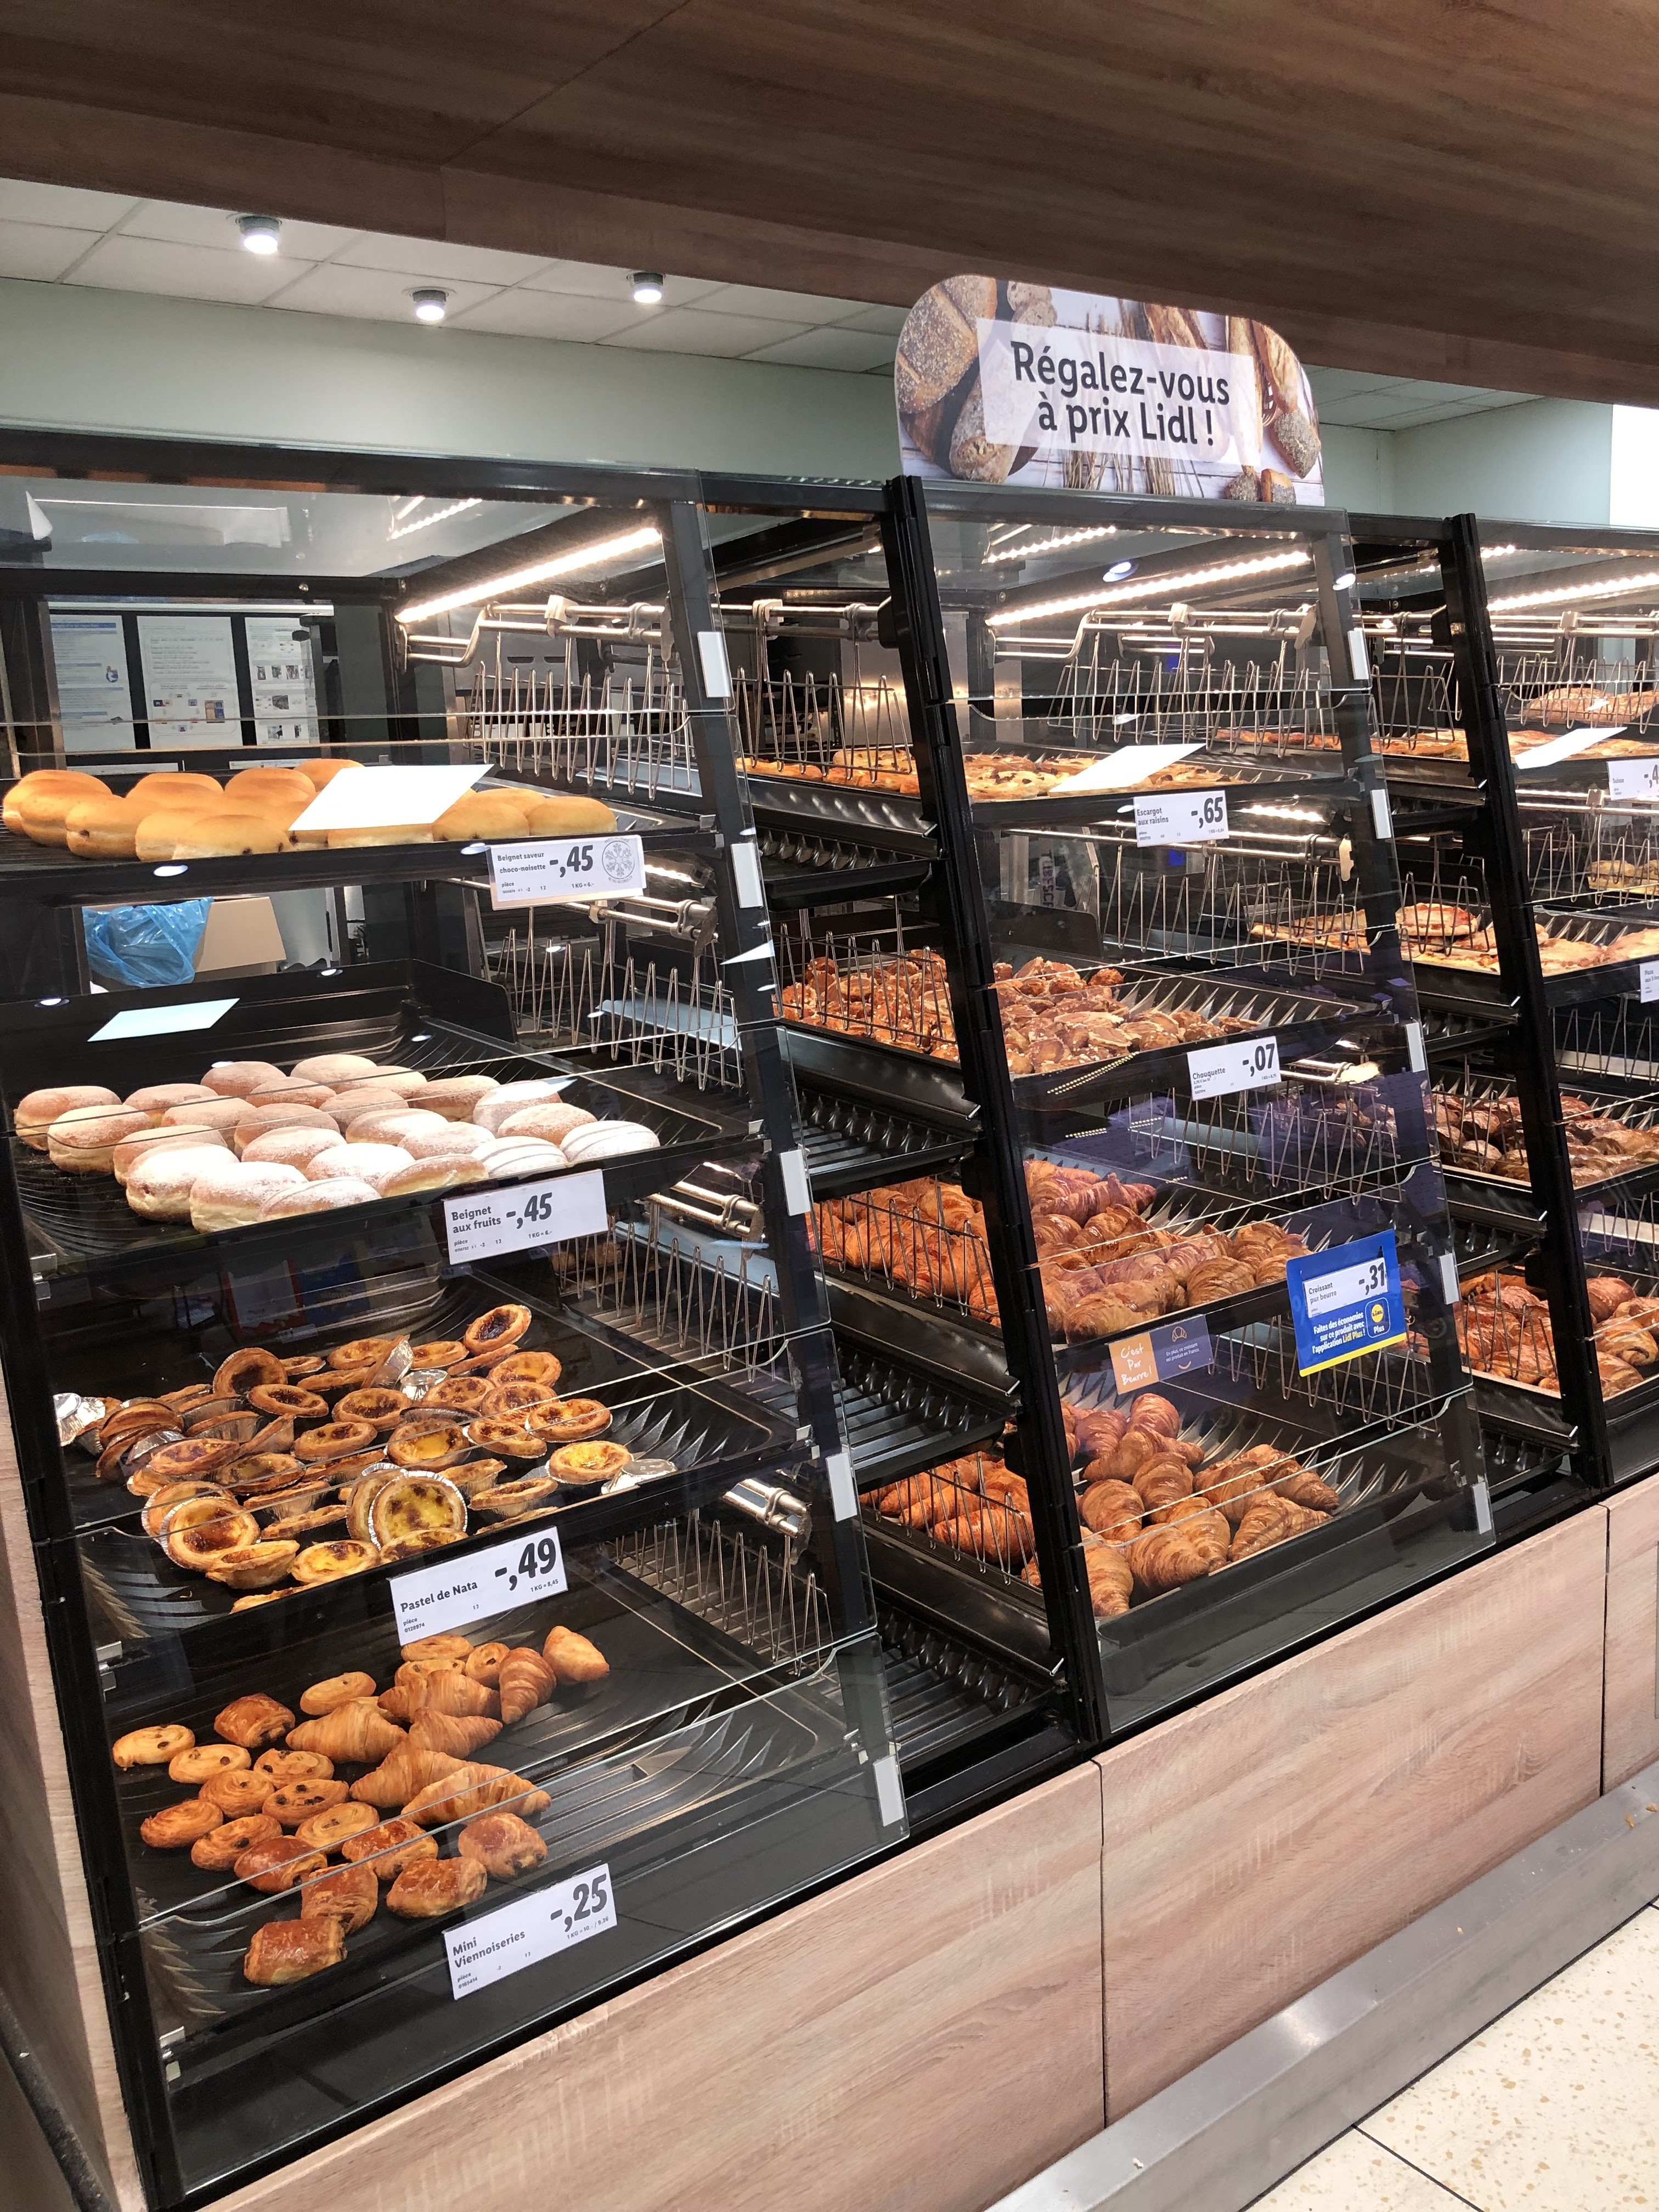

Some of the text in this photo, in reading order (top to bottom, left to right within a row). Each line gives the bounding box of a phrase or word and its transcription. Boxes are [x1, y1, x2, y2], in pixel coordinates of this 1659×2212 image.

[1011, 341, 1229, 405] Régalez-vous
[1039, 392, 1213, 446] à prix Lidl !
[1137, 808, 1163, 816] Escargot
[1191, 797, 1223, 828] -,65
[1150, 816, 1169, 825] raisins
[498, 854, 522, 862] Beignet
[550, 845, 594, 878] -,45
[500, 864, 546, 873] choco-noisette
[1242, 1043, 1275, 1077] -,07
[1193, 1068, 1226, 1080] Chouquette
[451, 1206, 492, 1221] Beignet
[506, 1192, 552, 1229] -,45
[453, 1217, 501, 1233] aux fruits
[1358, 1262, 1385, 1295] -,31
[1308, 1282, 1333, 1294] Croissant
[1319, 1291, 1337, 1301] beurre
[1313, 1312, 1364, 1334] Faites des économies
[1335, 1324, 1353, 1338] produit
[1353, 1321, 1365, 1330] avec
[1373, 1325, 1385, 1334] Plus
[1312, 1338, 1342, 1354] l'application
[1342, 1332, 1352, 1343] Lidl
[1352, 1330, 1363, 1340] Plus
[1120, 1343, 1144, 1358] C'est
[1127, 1359, 1141, 1370] Pur
[495, 1538, 556, 1591] -,49
[548, 1579, 558, 1588] 8,45
[400, 1582, 478, 1612] Pastel de Nata
[403, 1617, 417, 1627] pièce
[404, 1622, 425, 1633] 0128974
[550, 1874, 607, 1933] -,25
[453, 1937, 477, 1956] Mini
[454, 1931, 526, 1968] Viennoiseries
[458, 1973, 471, 1982] pièce
